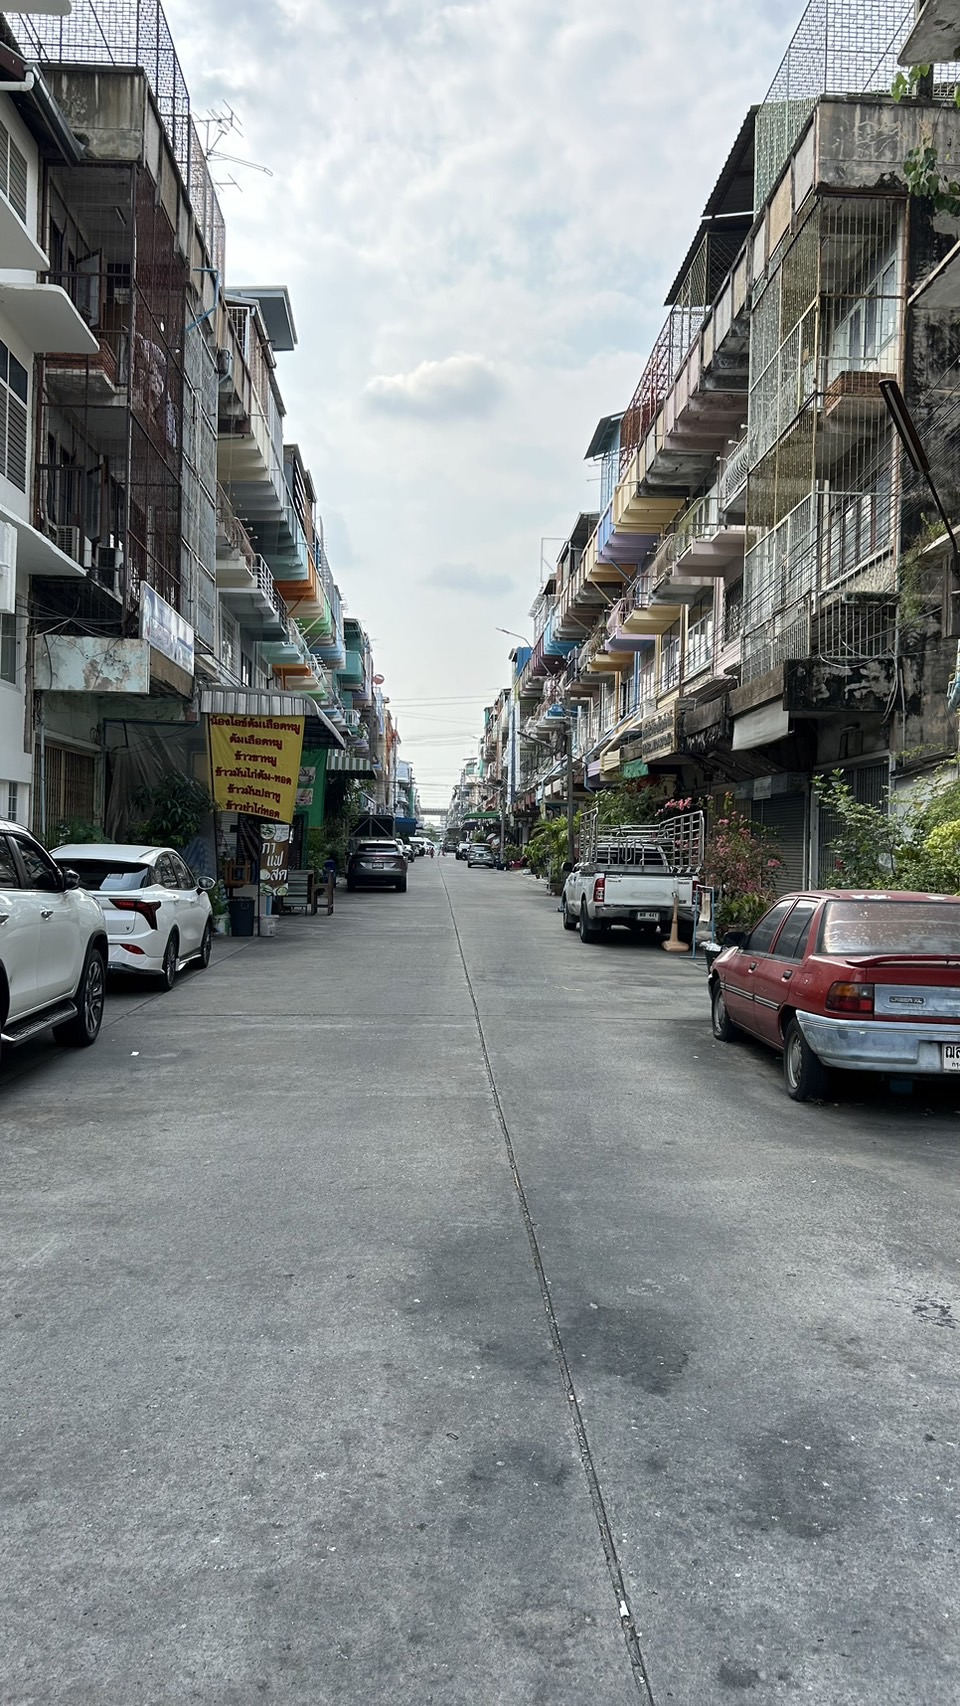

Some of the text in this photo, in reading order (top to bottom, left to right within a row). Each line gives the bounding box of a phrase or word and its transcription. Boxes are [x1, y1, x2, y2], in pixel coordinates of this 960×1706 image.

[229, 733, 283, 750] ต้มเลือดหมู
[234, 750, 277, 767] ข้าวขาหมู
[270, 868, 288, 881] สด
